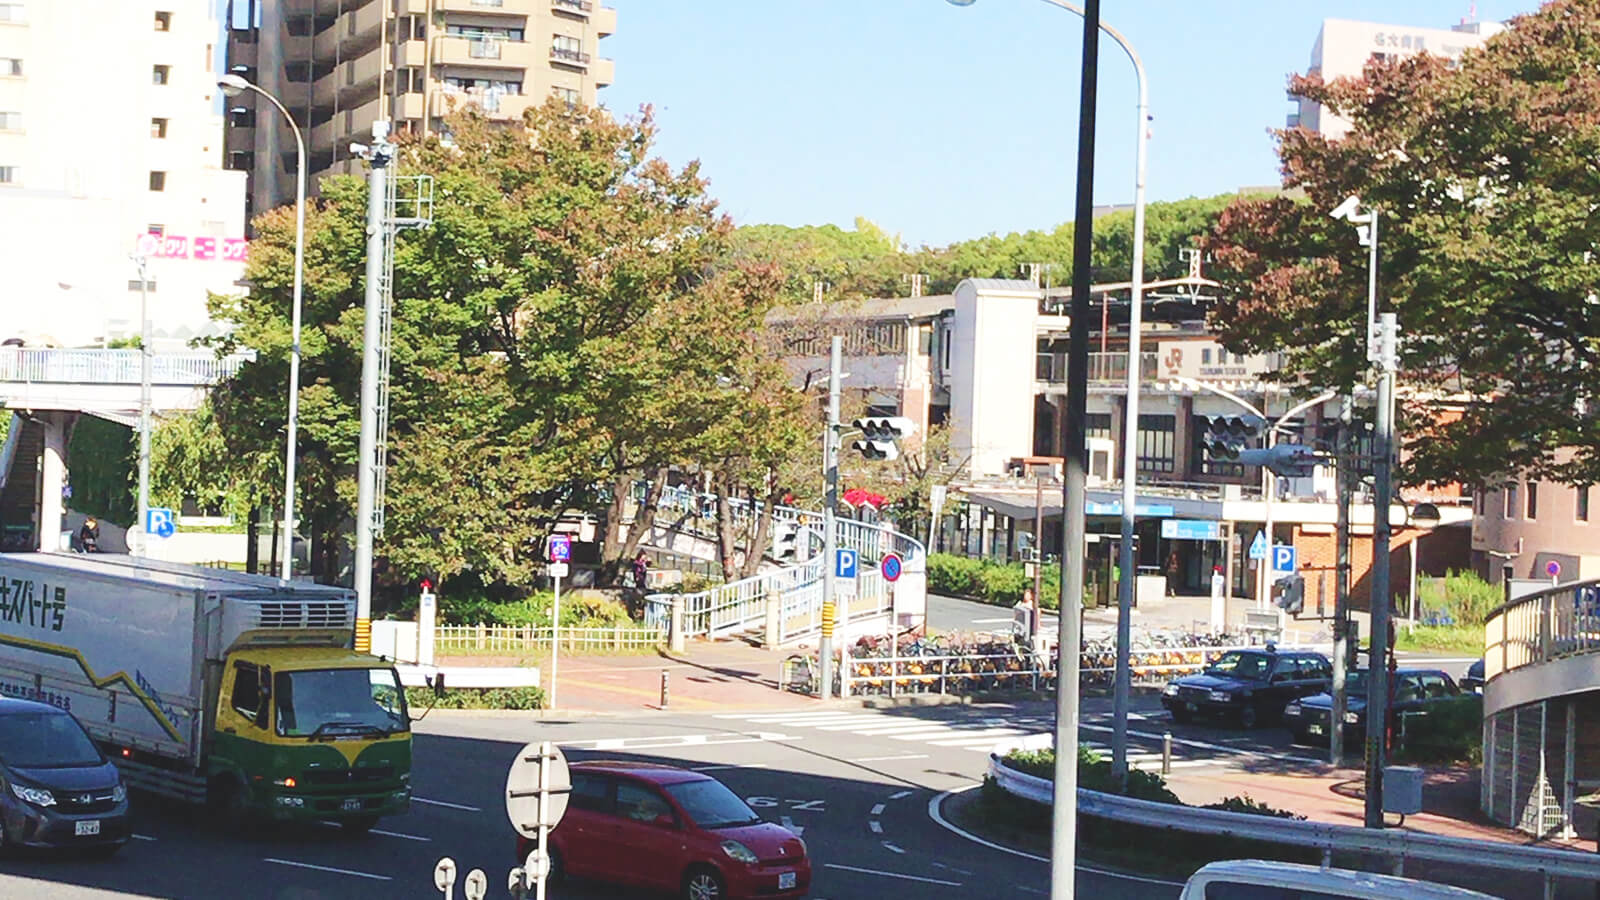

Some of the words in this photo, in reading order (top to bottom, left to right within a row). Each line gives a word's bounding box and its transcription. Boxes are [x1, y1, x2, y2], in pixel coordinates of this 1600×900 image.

[1165, 348, 1182, 368] JR
[151, 511, 167, 532] P
[841, 552, 853, 576] P
[1278, 549, 1291, 569] P
